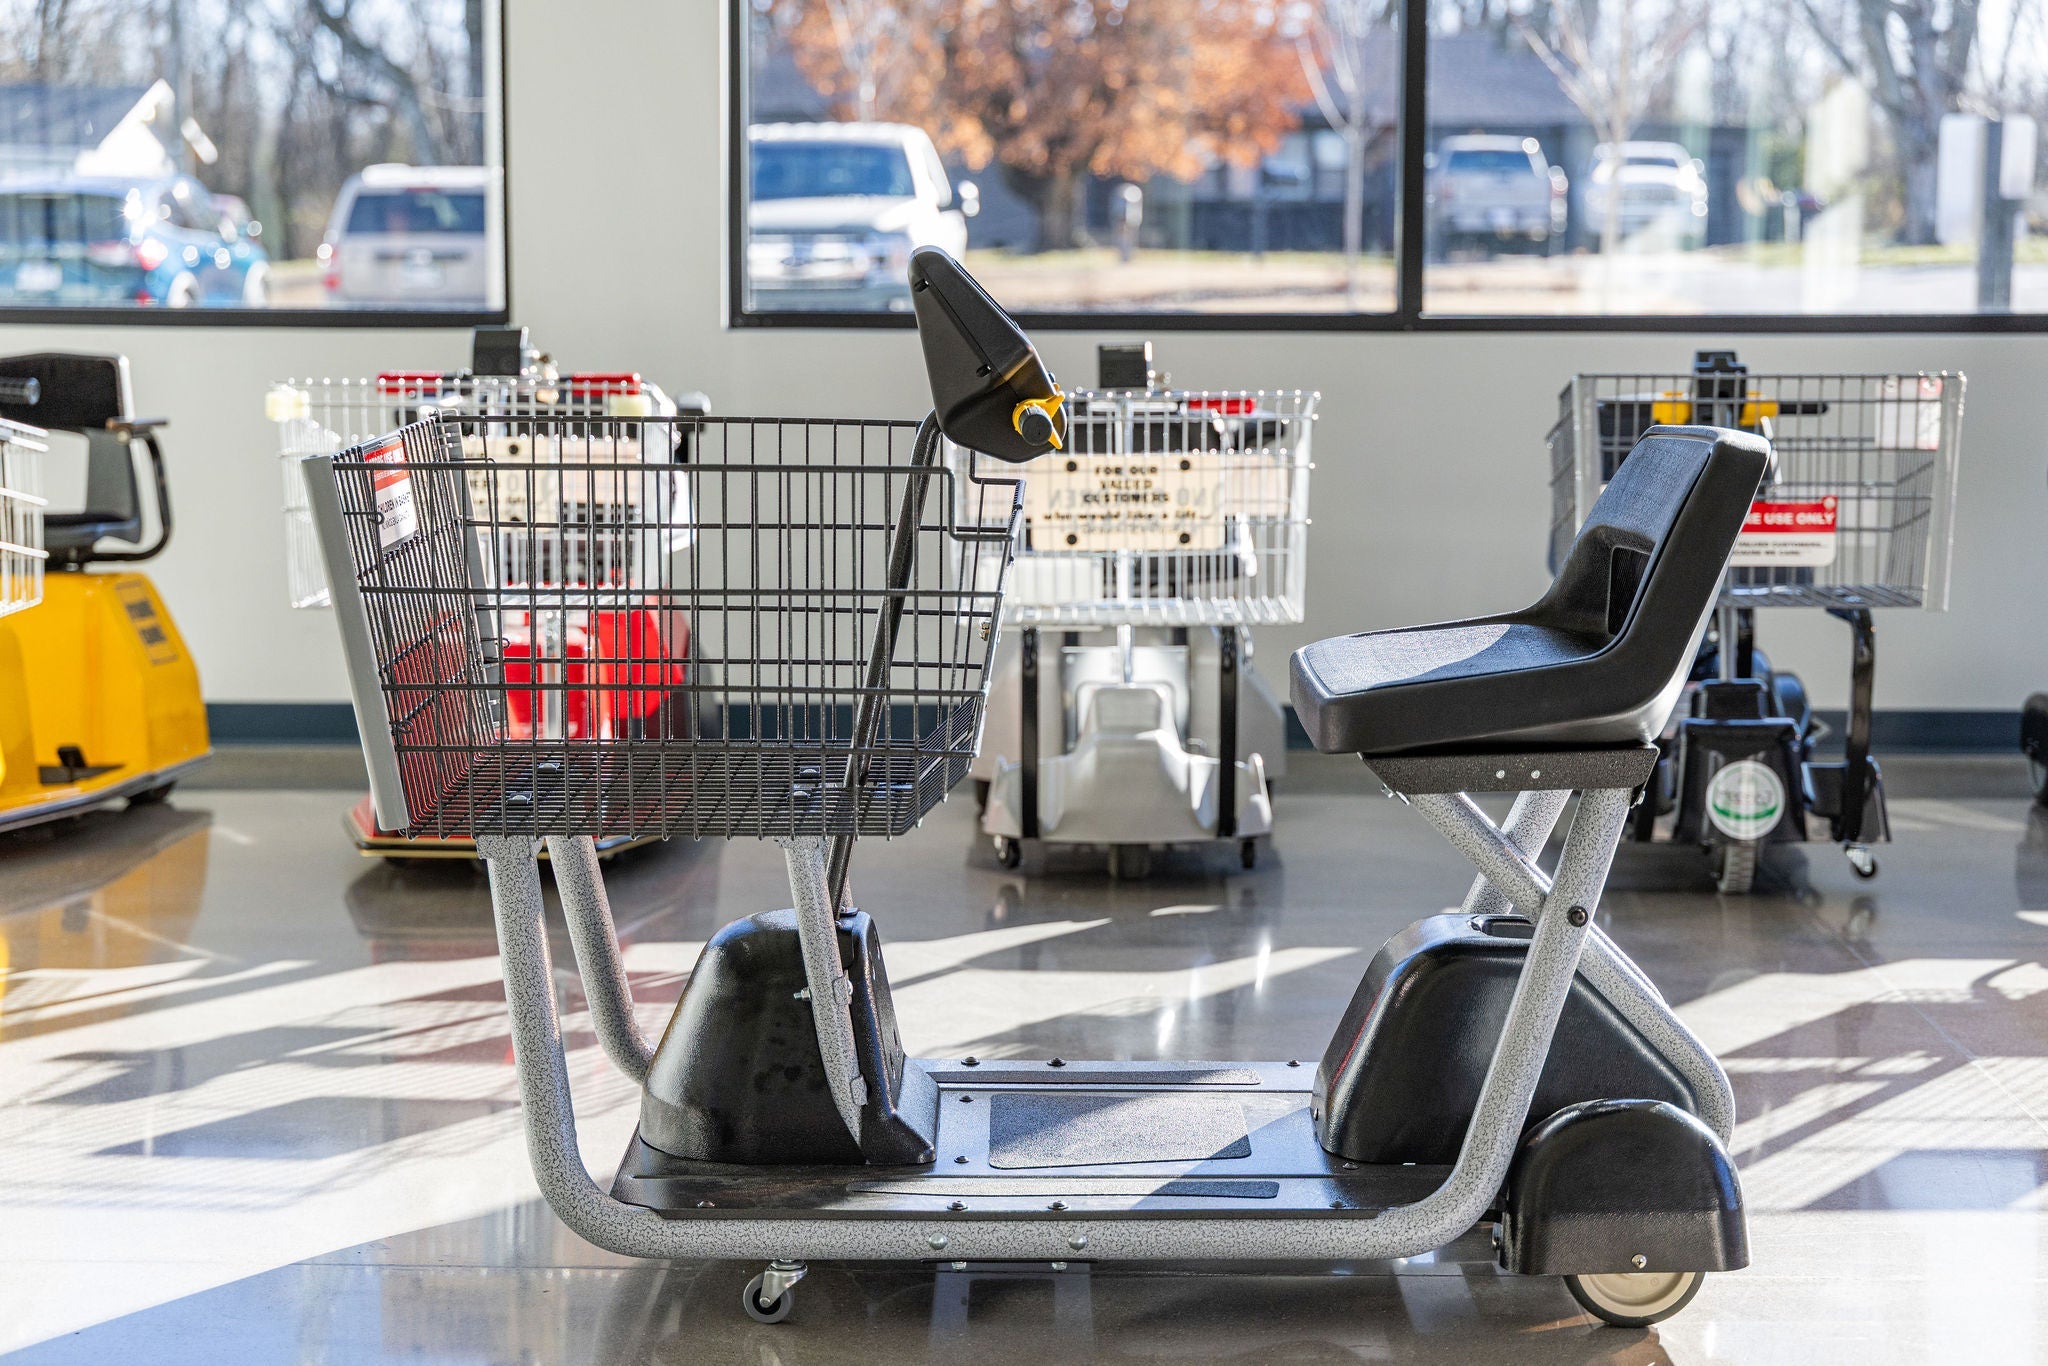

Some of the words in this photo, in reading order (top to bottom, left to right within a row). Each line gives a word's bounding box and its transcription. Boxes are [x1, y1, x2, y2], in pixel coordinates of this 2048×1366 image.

[1095, 466, 1123, 475] FOR
[1129, 466, 1159, 475] OUR
[1082, 492, 1169, 503] CUSTOMERS
[1763, 512, 1794, 525] USE
[1795, 511, 1835, 525] ONLY
